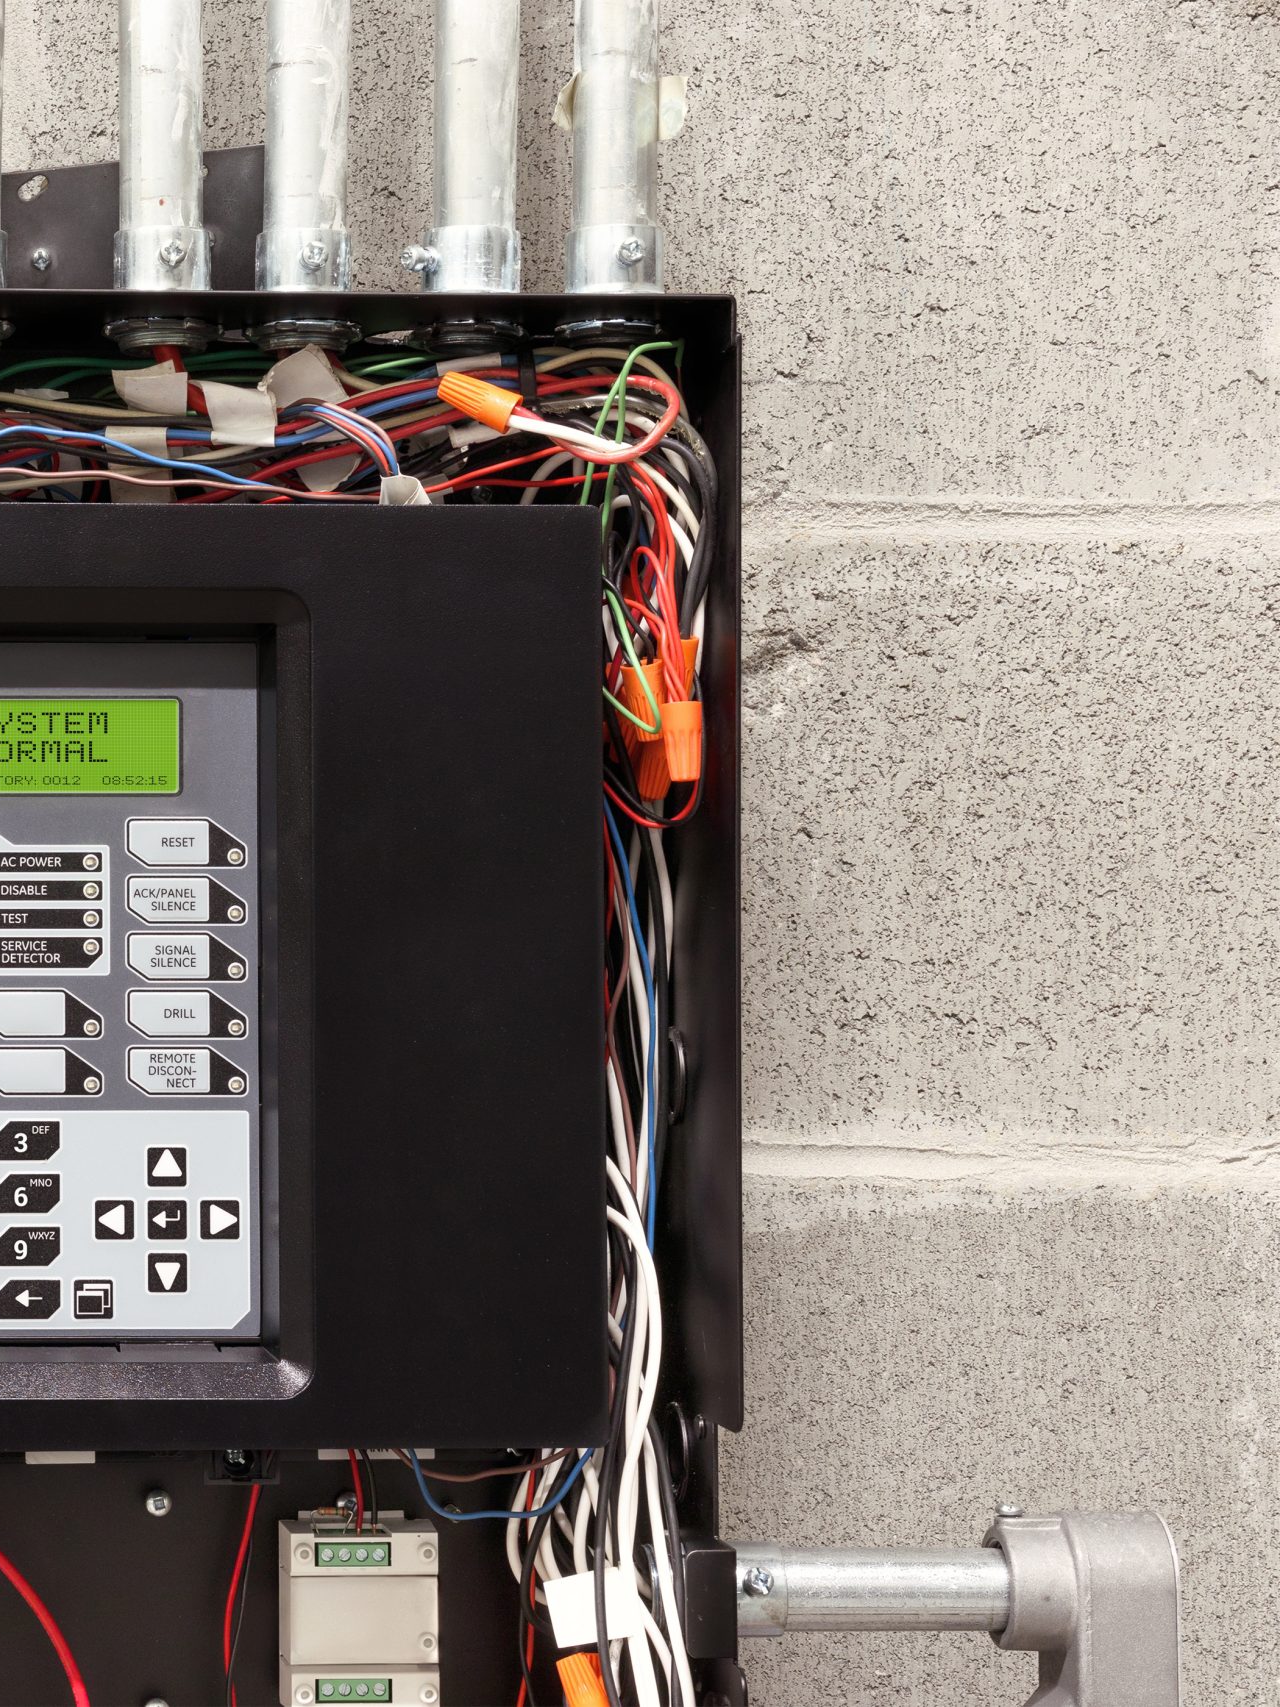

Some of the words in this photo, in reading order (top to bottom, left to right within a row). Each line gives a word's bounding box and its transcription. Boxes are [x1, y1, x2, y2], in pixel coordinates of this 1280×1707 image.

[43, 775, 80, 786] 0012
[102, 775, 167, 786] 08:52:15
[162, 838, 195, 847] RESET
[1, 857, 16, 867] AC
[20, 857, 61, 867] POWER
[1, 885, 47, 895] DISABLE
[134, 888, 195, 898] ACK/PANEL
[152, 901, 195, 911] SILENCE
[1, 914, 28, 923] TEST
[2, 941, 47, 951] SERVICE
[155, 945, 195, 955] SIGNAL
[2, 953, 60, 963] DETECTOR
[151, 958, 196, 967] SILENCE
[164, 1009, 195, 1018] DRILL
[150, 1054, 195, 1063] REMOTE
[149, 1066, 196, 1075] DISCON-
[167, 1078, 196, 1088] NECT
[32, 1126, 50, 1134] DEF
[14, 1133, 27, 1152] 3
[30, 1179, 52, 1187] MNO
[13, 1186, 28, 1207] 6
[28, 1232, 55, 1240] WXYZ
[13, 1239, 28, 1260] 9
